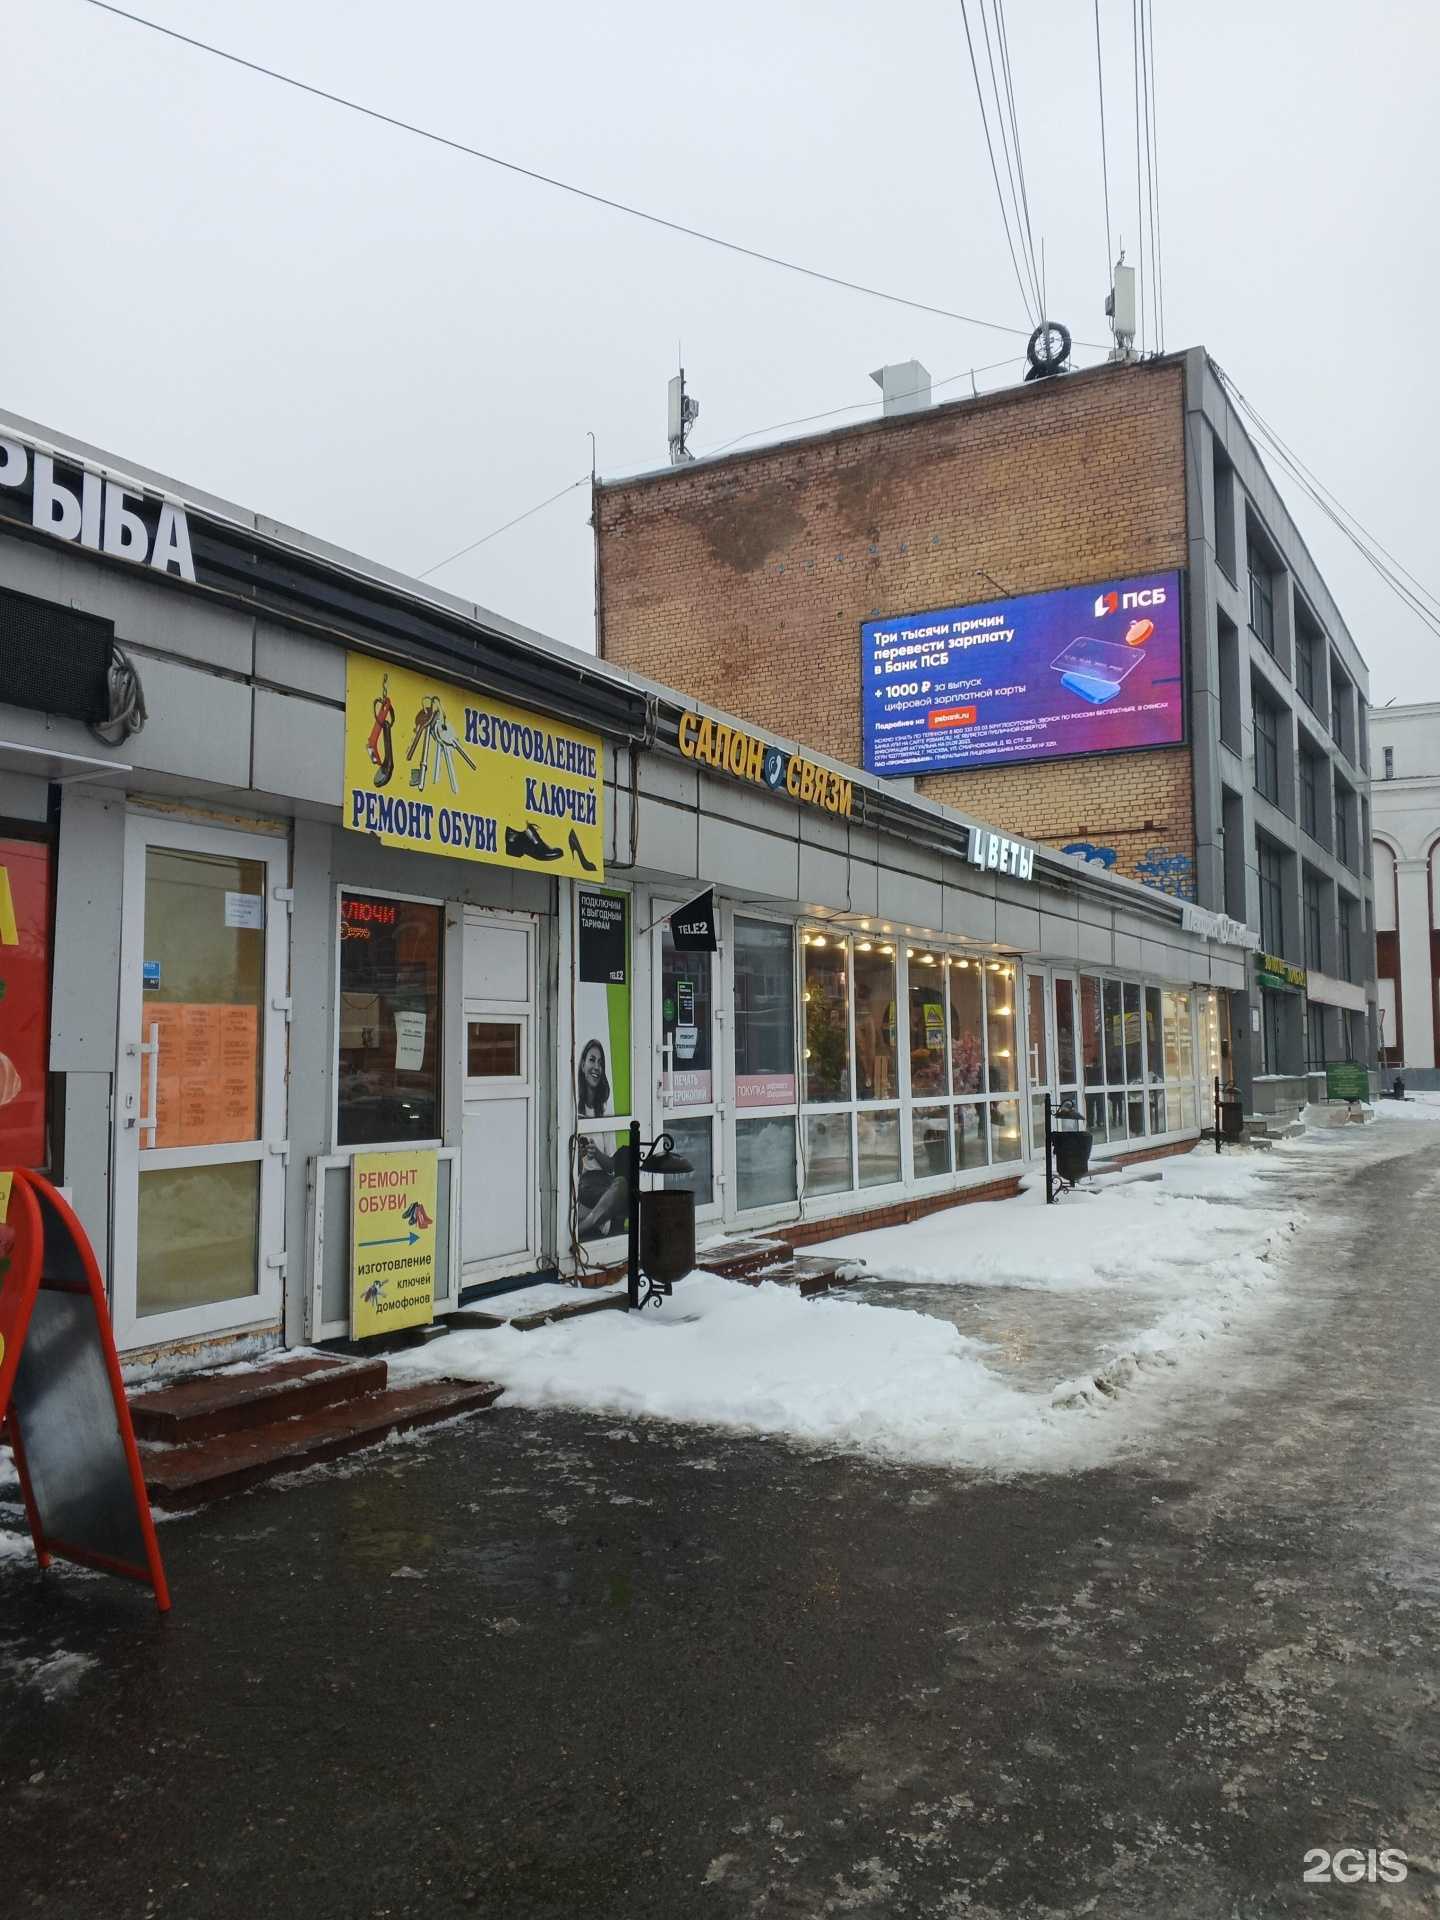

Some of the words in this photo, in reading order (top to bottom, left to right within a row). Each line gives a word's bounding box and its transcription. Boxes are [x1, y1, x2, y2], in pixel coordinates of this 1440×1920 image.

[1122, 587, 1166, 609] ПСБ
[873, 631, 898, 647] Три
[900, 624, 949, 640] тысячи
[952, 615, 1004, 634] причин
[874, 640, 945, 660] перевести
[948, 629, 1015, 649] зарплату
[874, 665, 882, 675] в
[885, 658, 917, 673] Банк
[920, 652, 949, 668] ПСБ
[884, 697, 932, 712] цифровой
[934, 690, 993, 706] зарплатной
[995, 684, 1027, 699] карты
[885, 682, 918, 698] 1000
[934, 683, 946, 692] за
[947, 678, 982, 691] выпуск
[464, 707, 597, 779] ИЗГОТОВЛЕНИЕ
[678, 709, 764, 784] САЛОН
[785, 755, 852, 817] СВЯЗИ
[524, 777, 597, 826] КЛЮЧЕЙ
[352, 789, 433, 841] РЕМОНТ
[438, 807, 498, 853] ОБУВИ
[971, 827, 1034, 881] ЦВЕТЫ
[581, 908, 587, 916] К
[582, 918, 610, 930] ТАРИФАМ
[678, 921, 709, 935] TELE2
[609, 970, 624, 981] TELE2
[359, 1169, 418, 1190] РЕМОНТ
[358, 1194, 407, 1214] ОБУВИ
[358, 1254, 432, 1276] изготовление
[397, 1272, 431, 1289] ключей
[376, 1293, 431, 1314] домофонов
